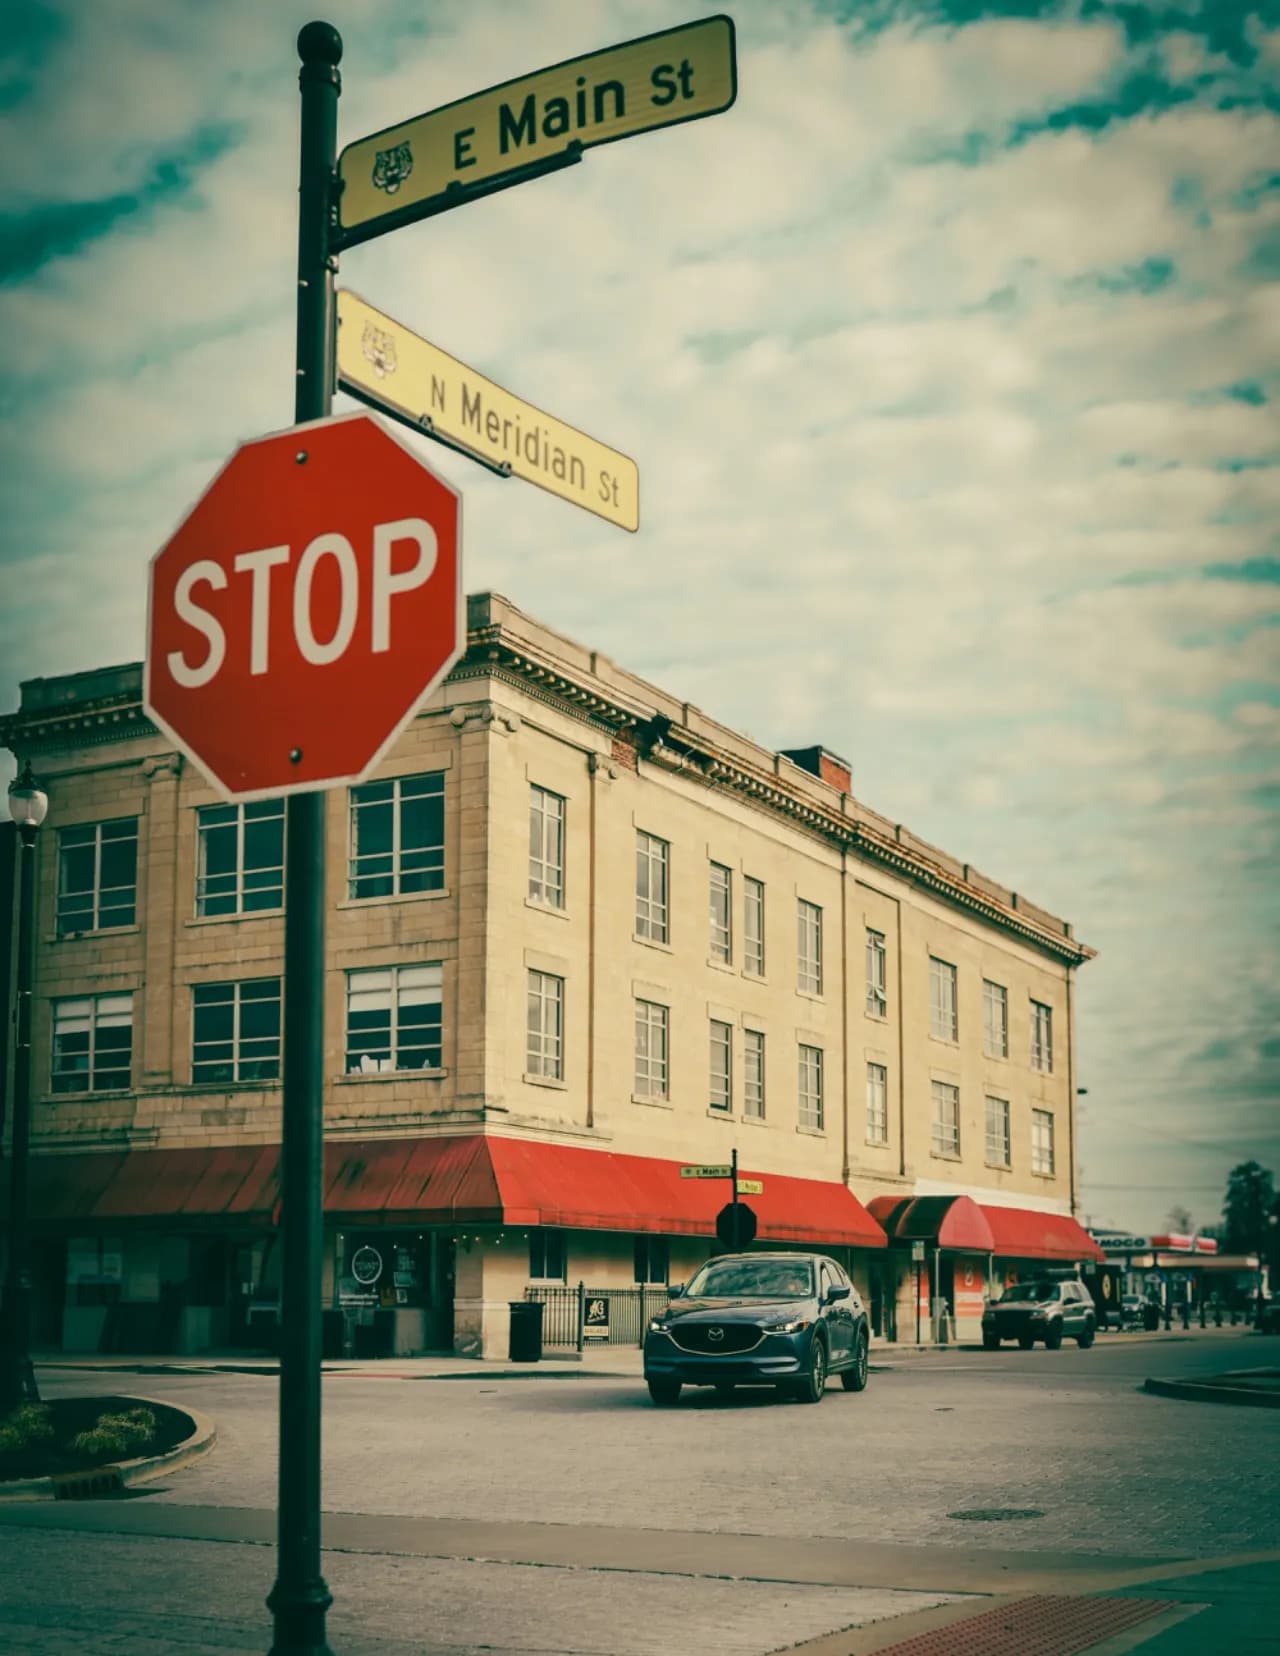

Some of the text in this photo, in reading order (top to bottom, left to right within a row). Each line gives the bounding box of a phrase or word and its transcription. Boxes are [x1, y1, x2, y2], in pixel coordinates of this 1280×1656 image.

[453, 59, 695, 170] E Main St
[431, 375, 620, 508] N Meridian St
[166, 517, 439, 689] STOP
[1094, 1238, 1146, 1248] MOCO
